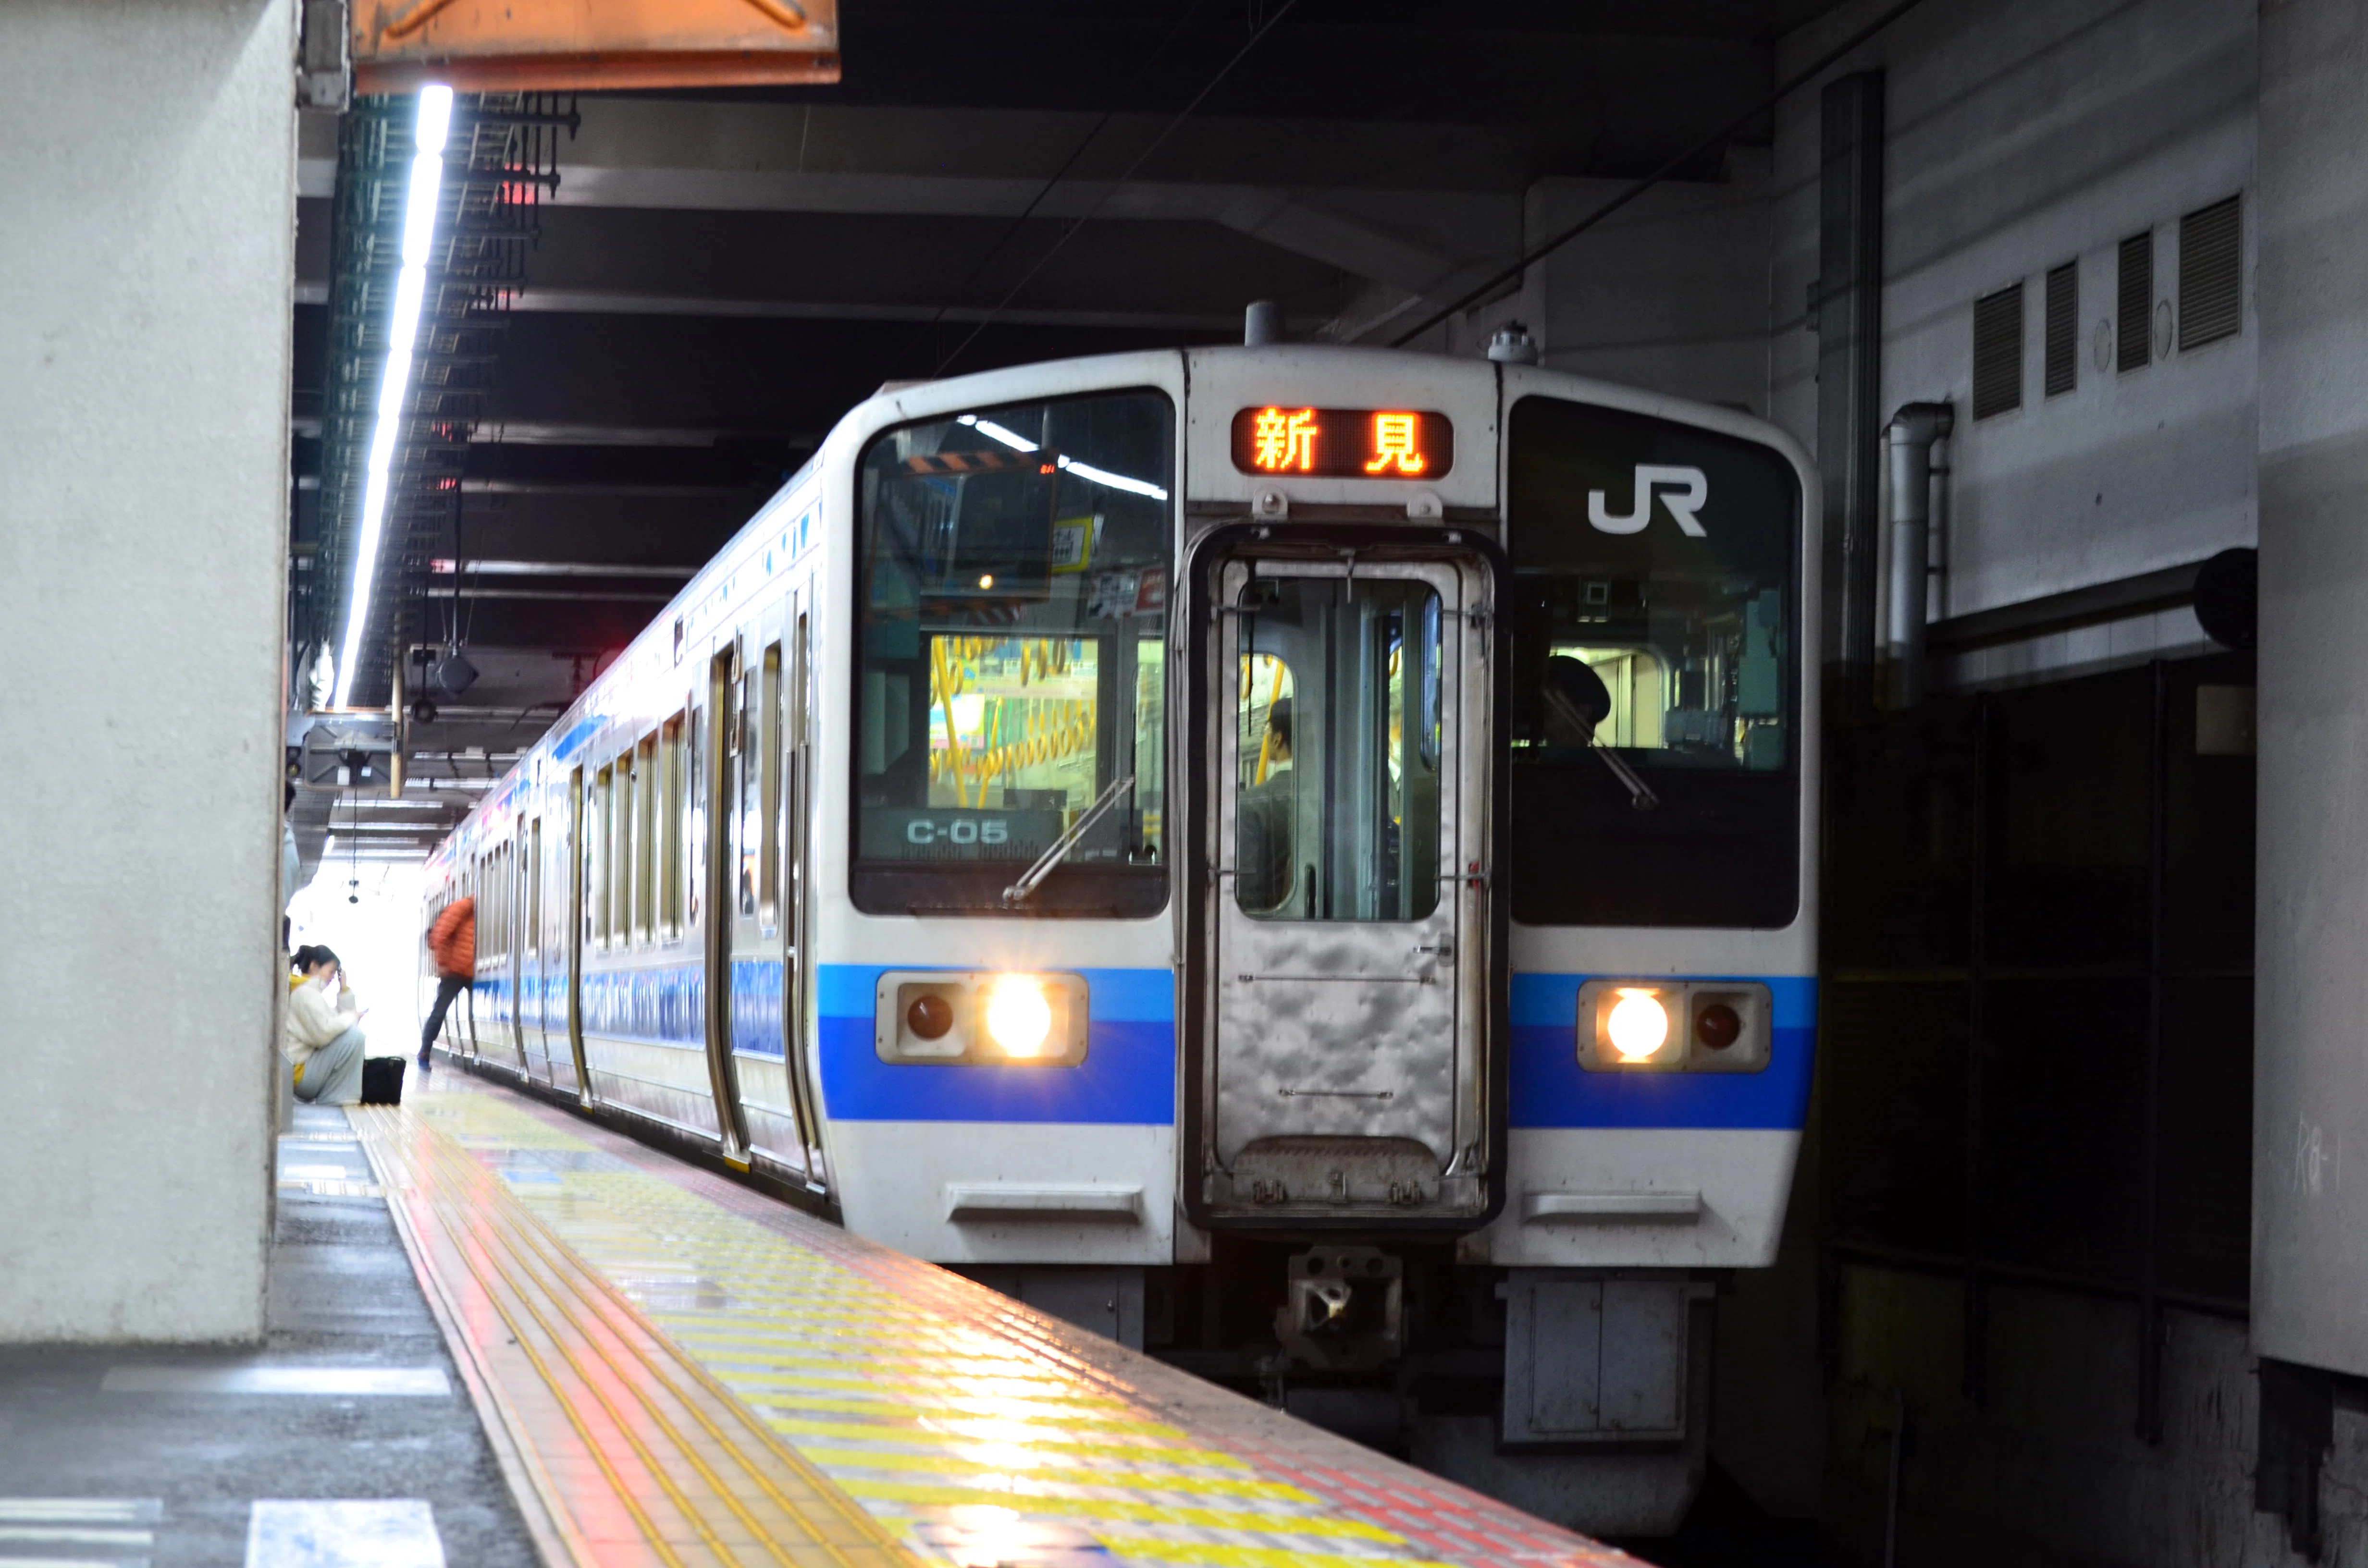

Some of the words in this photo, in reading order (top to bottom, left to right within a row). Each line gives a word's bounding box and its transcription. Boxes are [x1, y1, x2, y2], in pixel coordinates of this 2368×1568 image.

[1255, 406, 1425, 474] 新見
[1588, 464, 1708, 537] JR
[907, 819, 1008, 844] C-05
